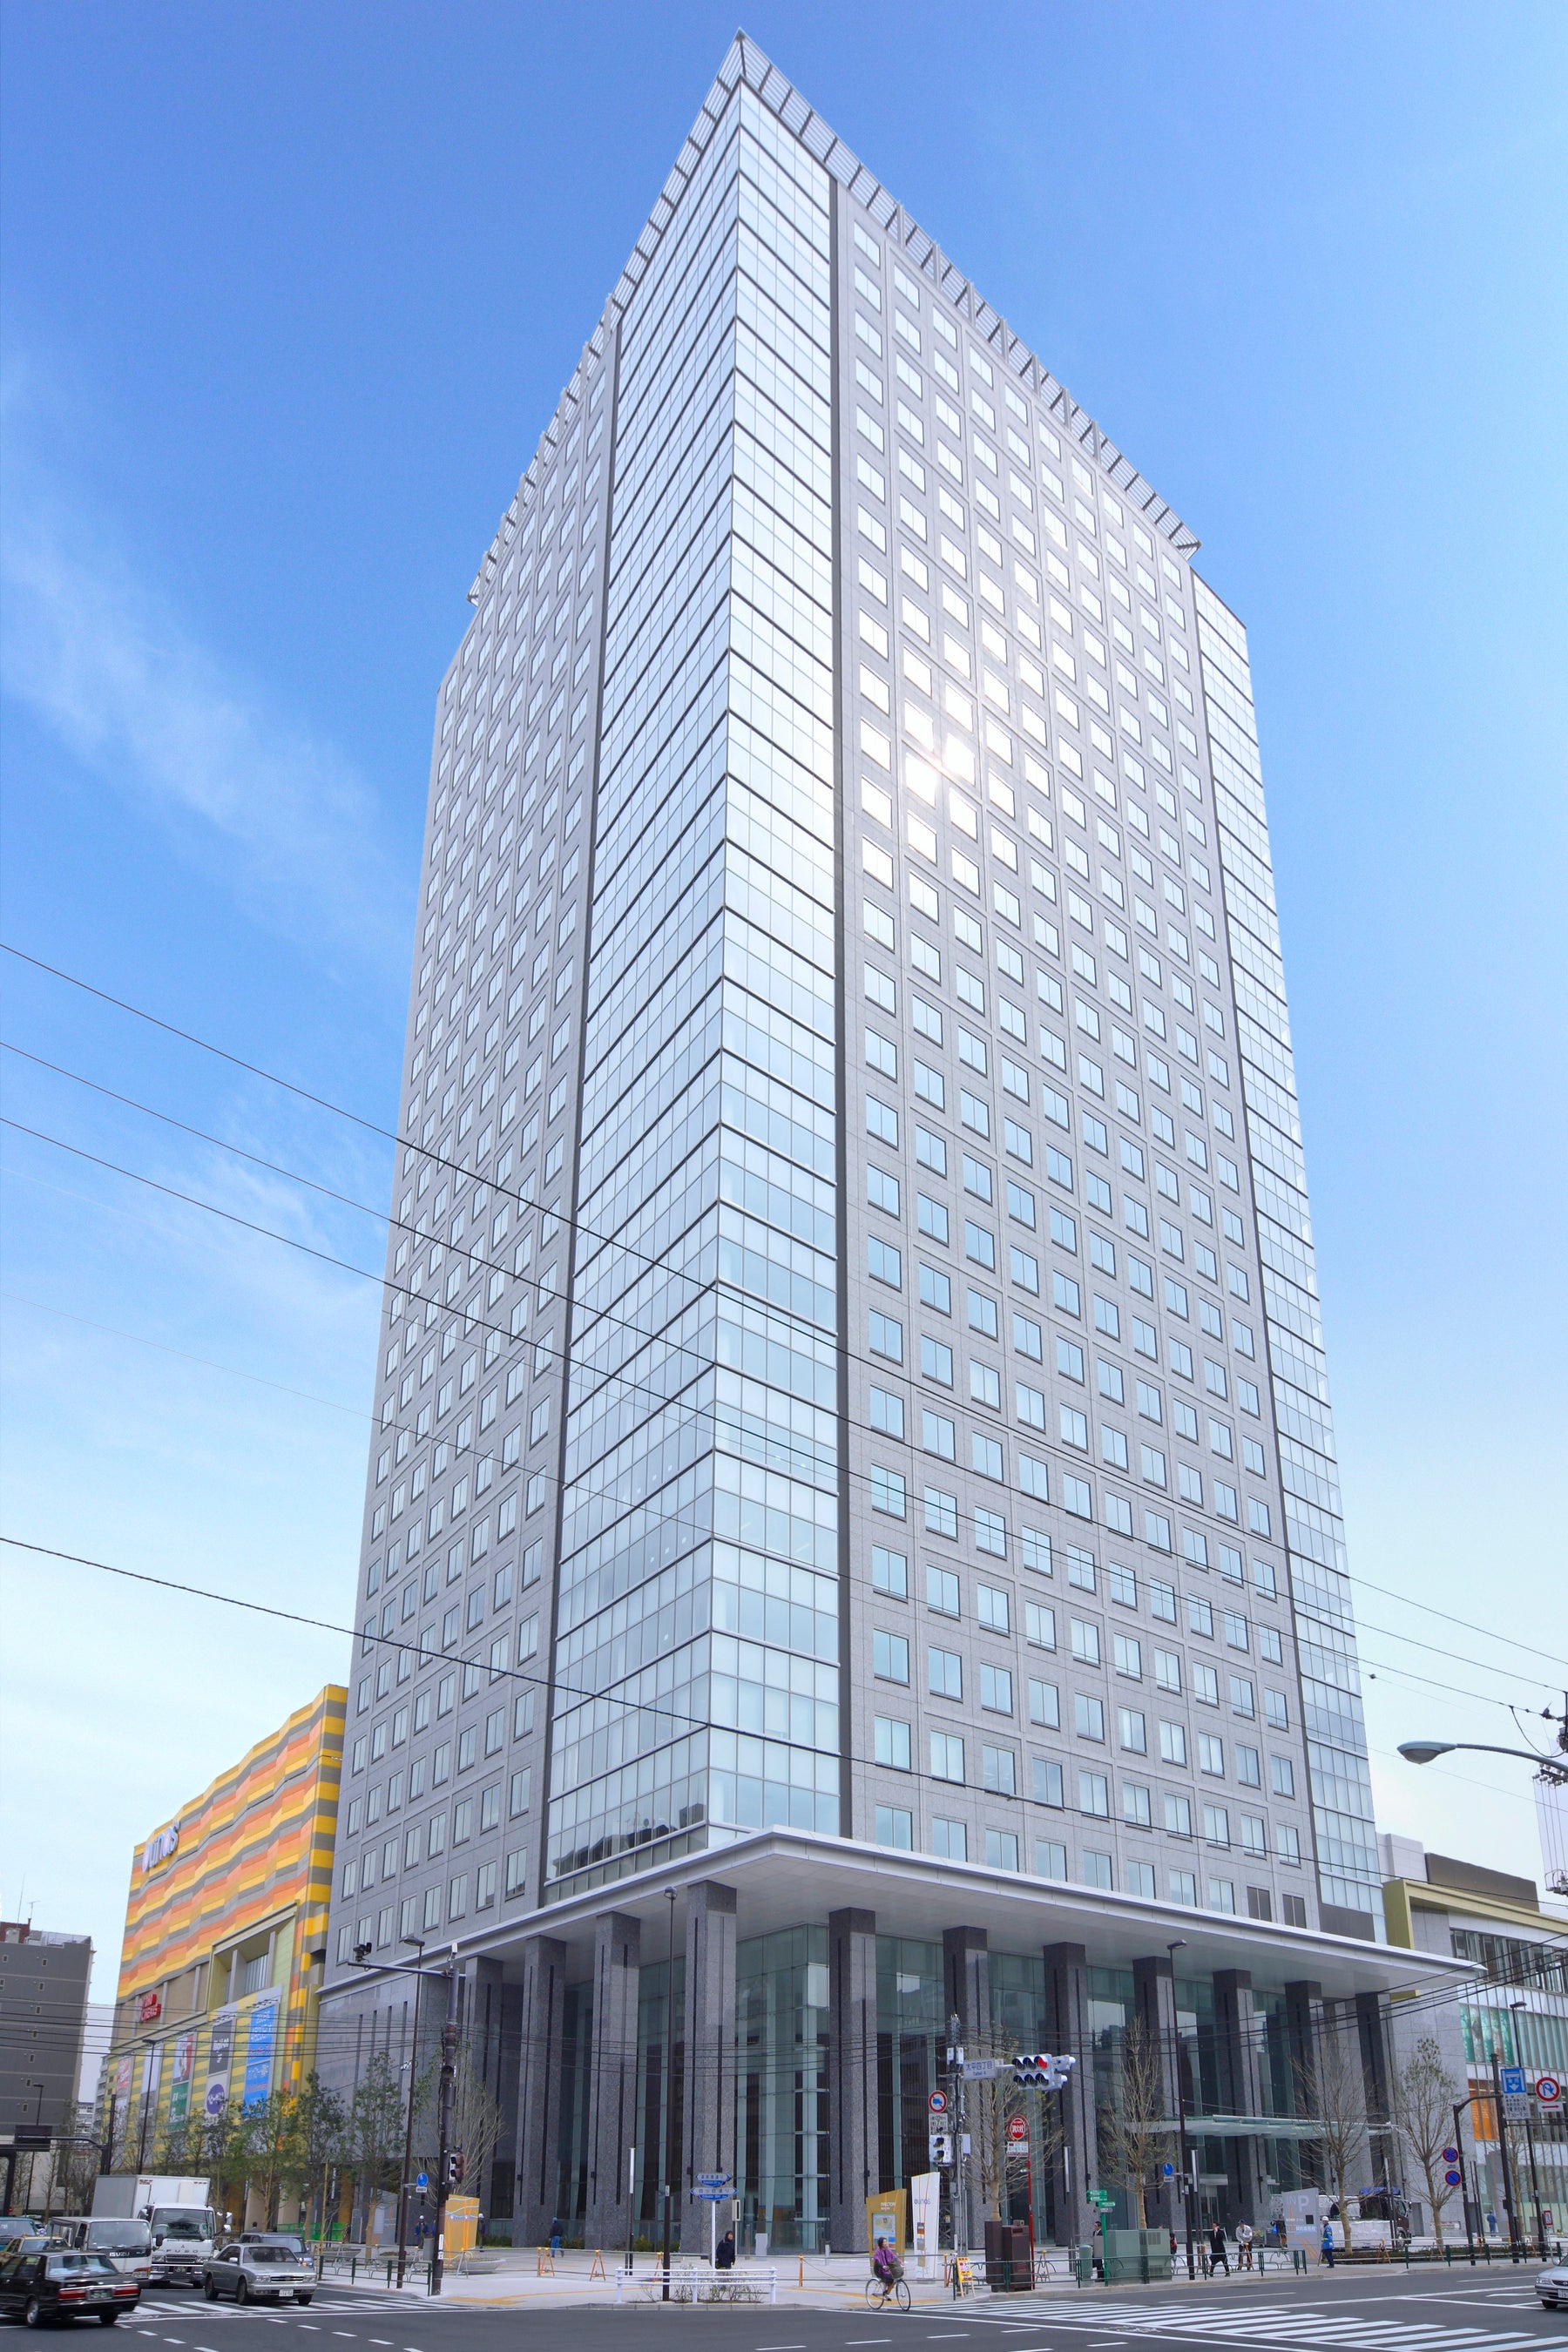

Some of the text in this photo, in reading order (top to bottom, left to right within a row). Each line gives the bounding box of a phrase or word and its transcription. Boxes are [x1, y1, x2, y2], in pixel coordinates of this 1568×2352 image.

[965, 2060, 992, 2071] 太平四丁目
[1298, 2195, 1309, 2212] P
